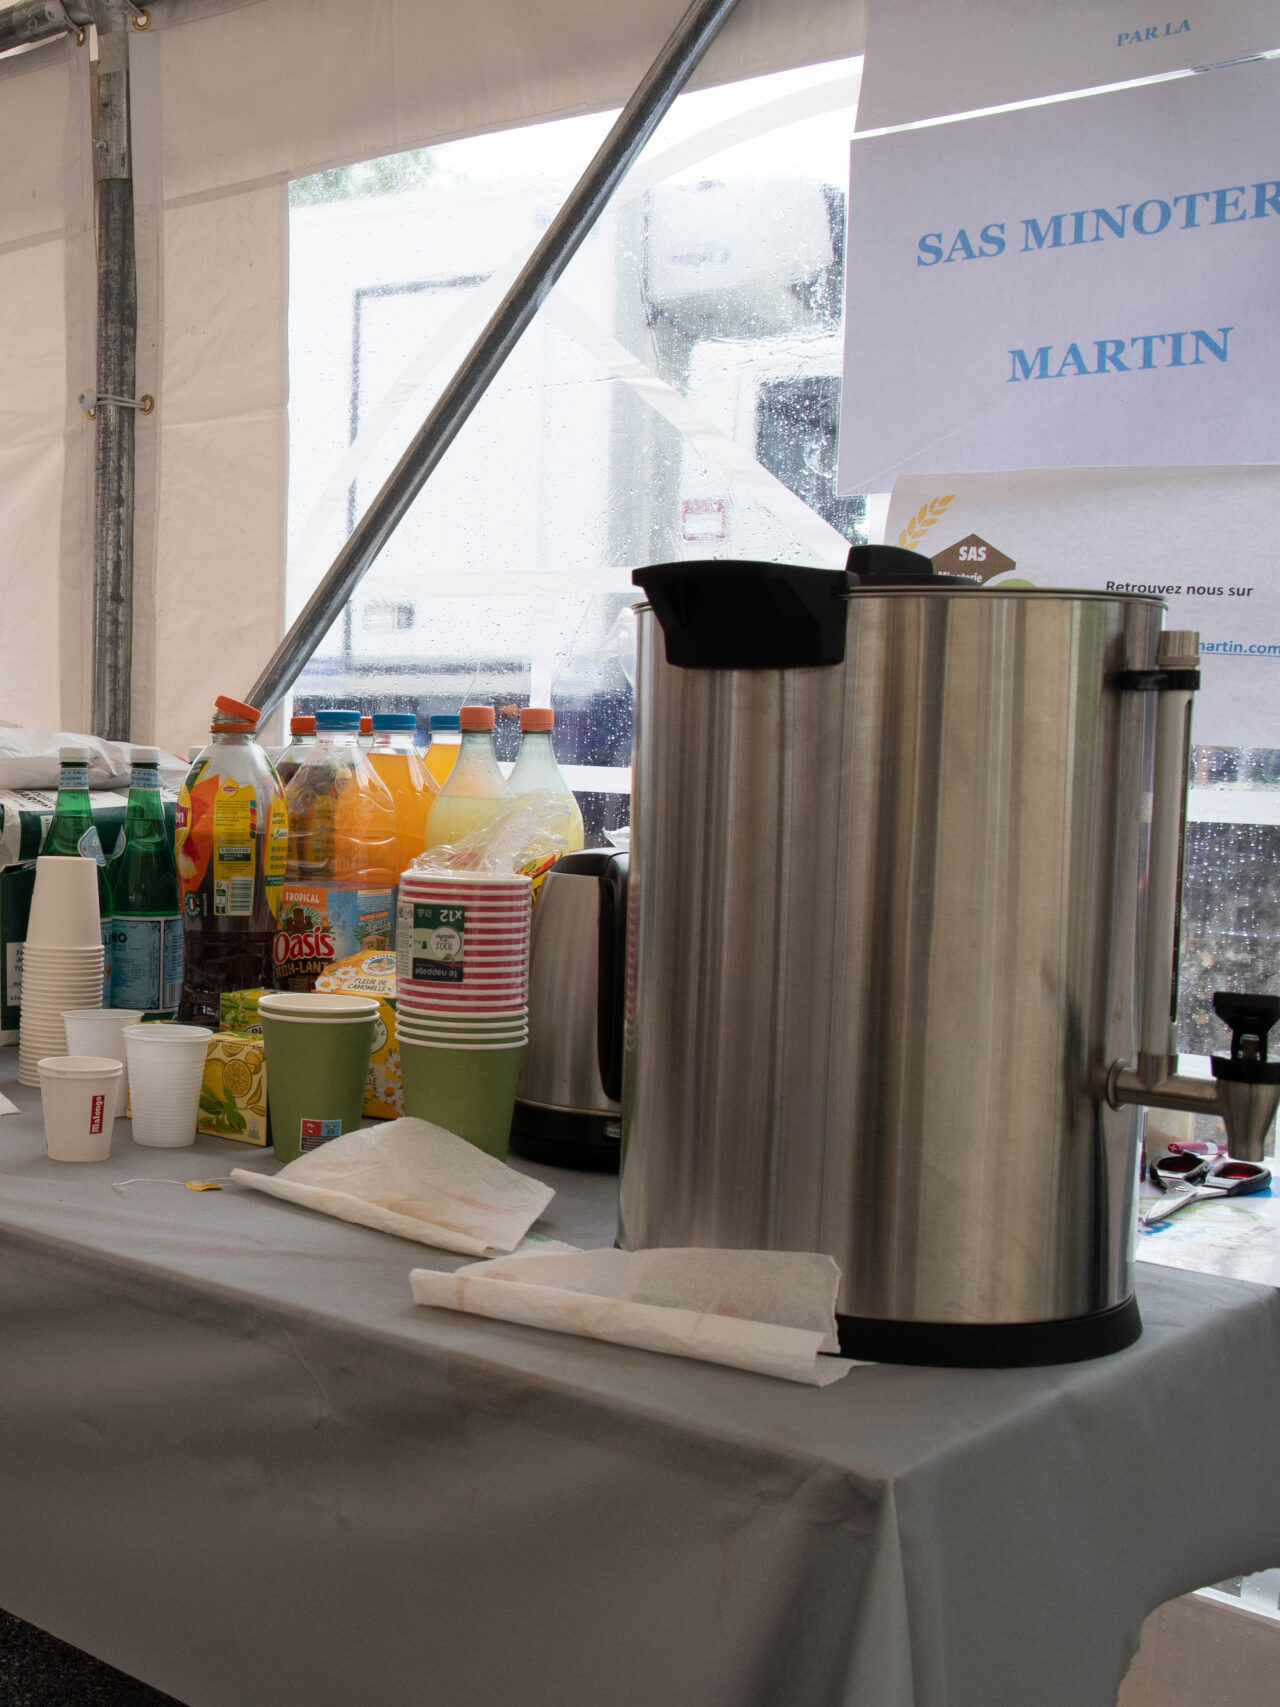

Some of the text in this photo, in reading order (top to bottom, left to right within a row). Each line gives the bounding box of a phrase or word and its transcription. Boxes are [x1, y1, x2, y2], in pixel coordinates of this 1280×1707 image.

[1115, 18, 1191, 47] PAR LA
[916, 222, 1007, 267] SAS
[1006, 327, 1234, 382] MARTIN
[958, 546, 986, 561] SAS
[1106, 581, 1253, 596] Retrouvez nous sur
[285, 892, 319, 903] TROPICAL
[440, 910, 463, 922] x12
[275, 926, 335, 963] Oasis
[348, 984, 387, 992] CAMOMILLE
[91, 1096, 104, 1134] Malongo
